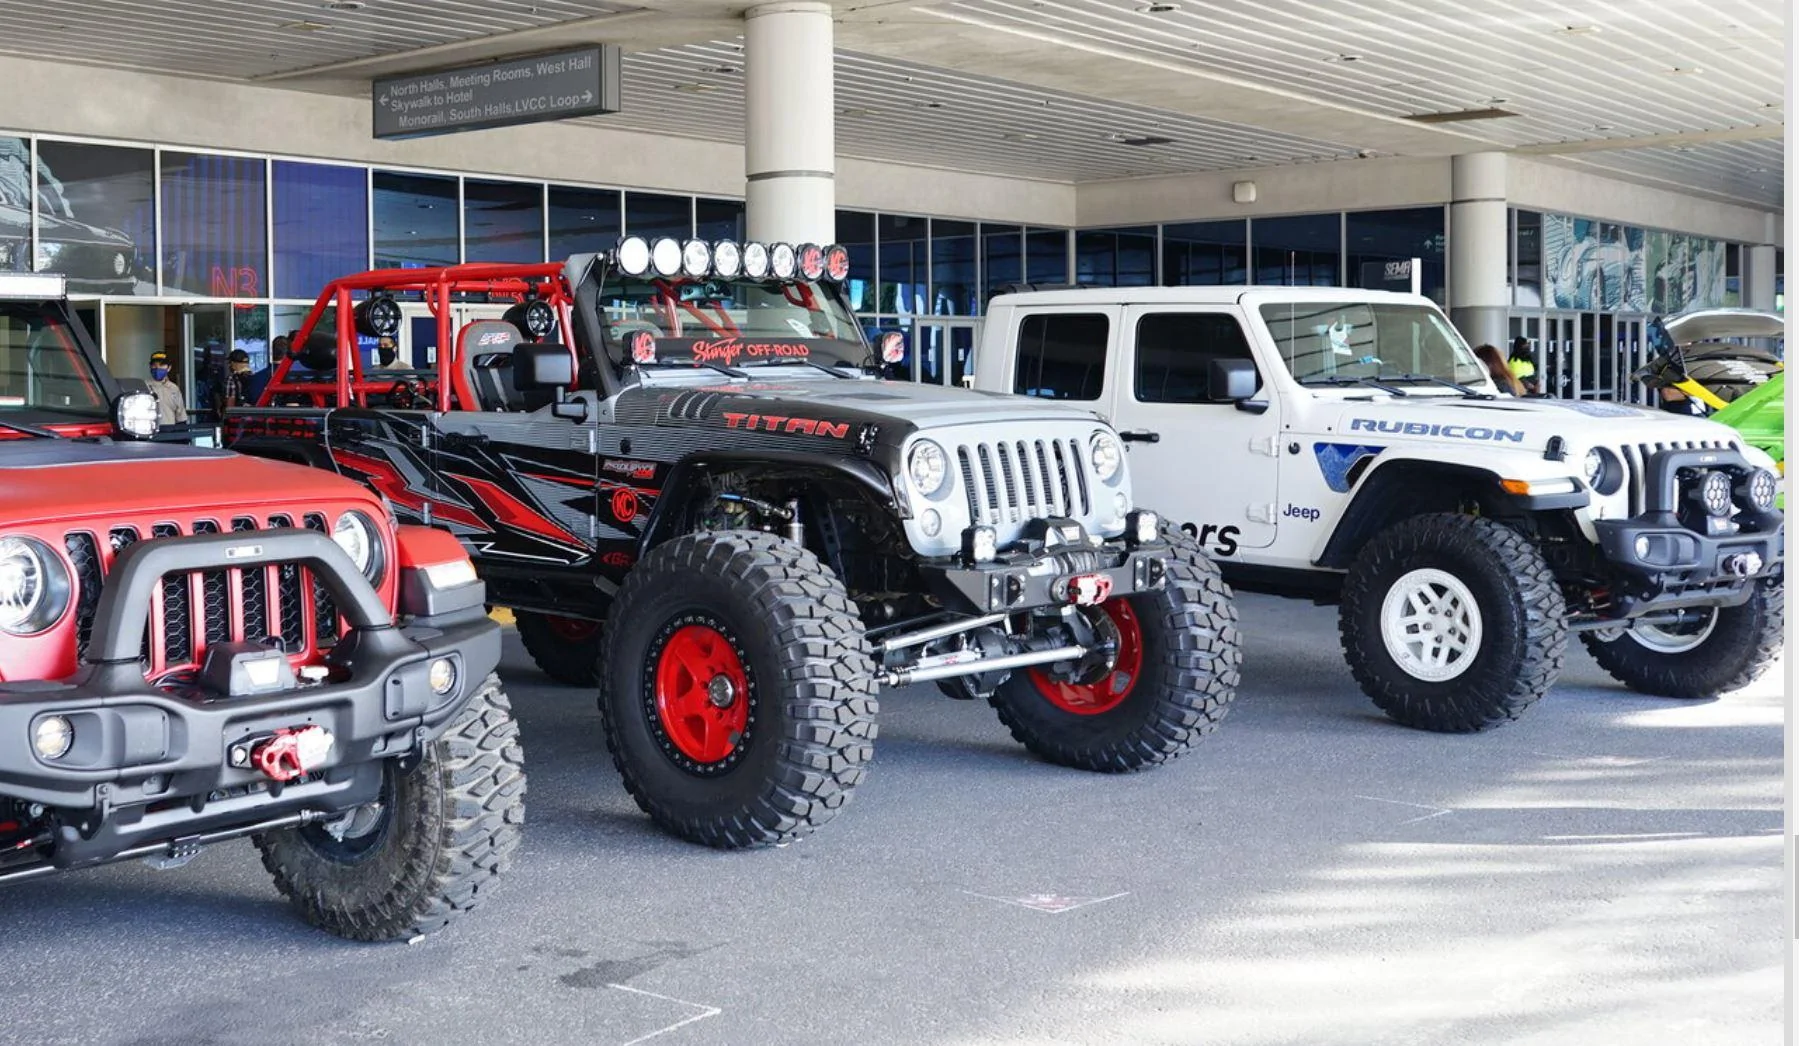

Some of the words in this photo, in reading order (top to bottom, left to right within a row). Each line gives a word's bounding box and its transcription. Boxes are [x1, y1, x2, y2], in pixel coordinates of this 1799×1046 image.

[390, 84, 419, 97] North
[420, 78, 447, 93] Halls,
[449, 73, 491, 88] Meeting
[493, 68, 534, 83] Rooms,
[536, 61, 566, 76] West
[568, 55, 593, 71] Hall
[390, 98, 433, 113] Skywalk
[434, 95, 444, 106] to
[446, 89, 473, 105] Hotel
[399, 111, 447, 128] Monorail,
[449, 105, 482, 121] South
[550, 94, 580, 108] Loop
[692, 337, 743, 366] Stinger
[746, 343, 809, 357] OFF-ROAD
[723, 412, 850, 438] TITAN
[1350, 418, 1525, 443] RUBICON
[1283, 503, 1320, 522] Jeep
